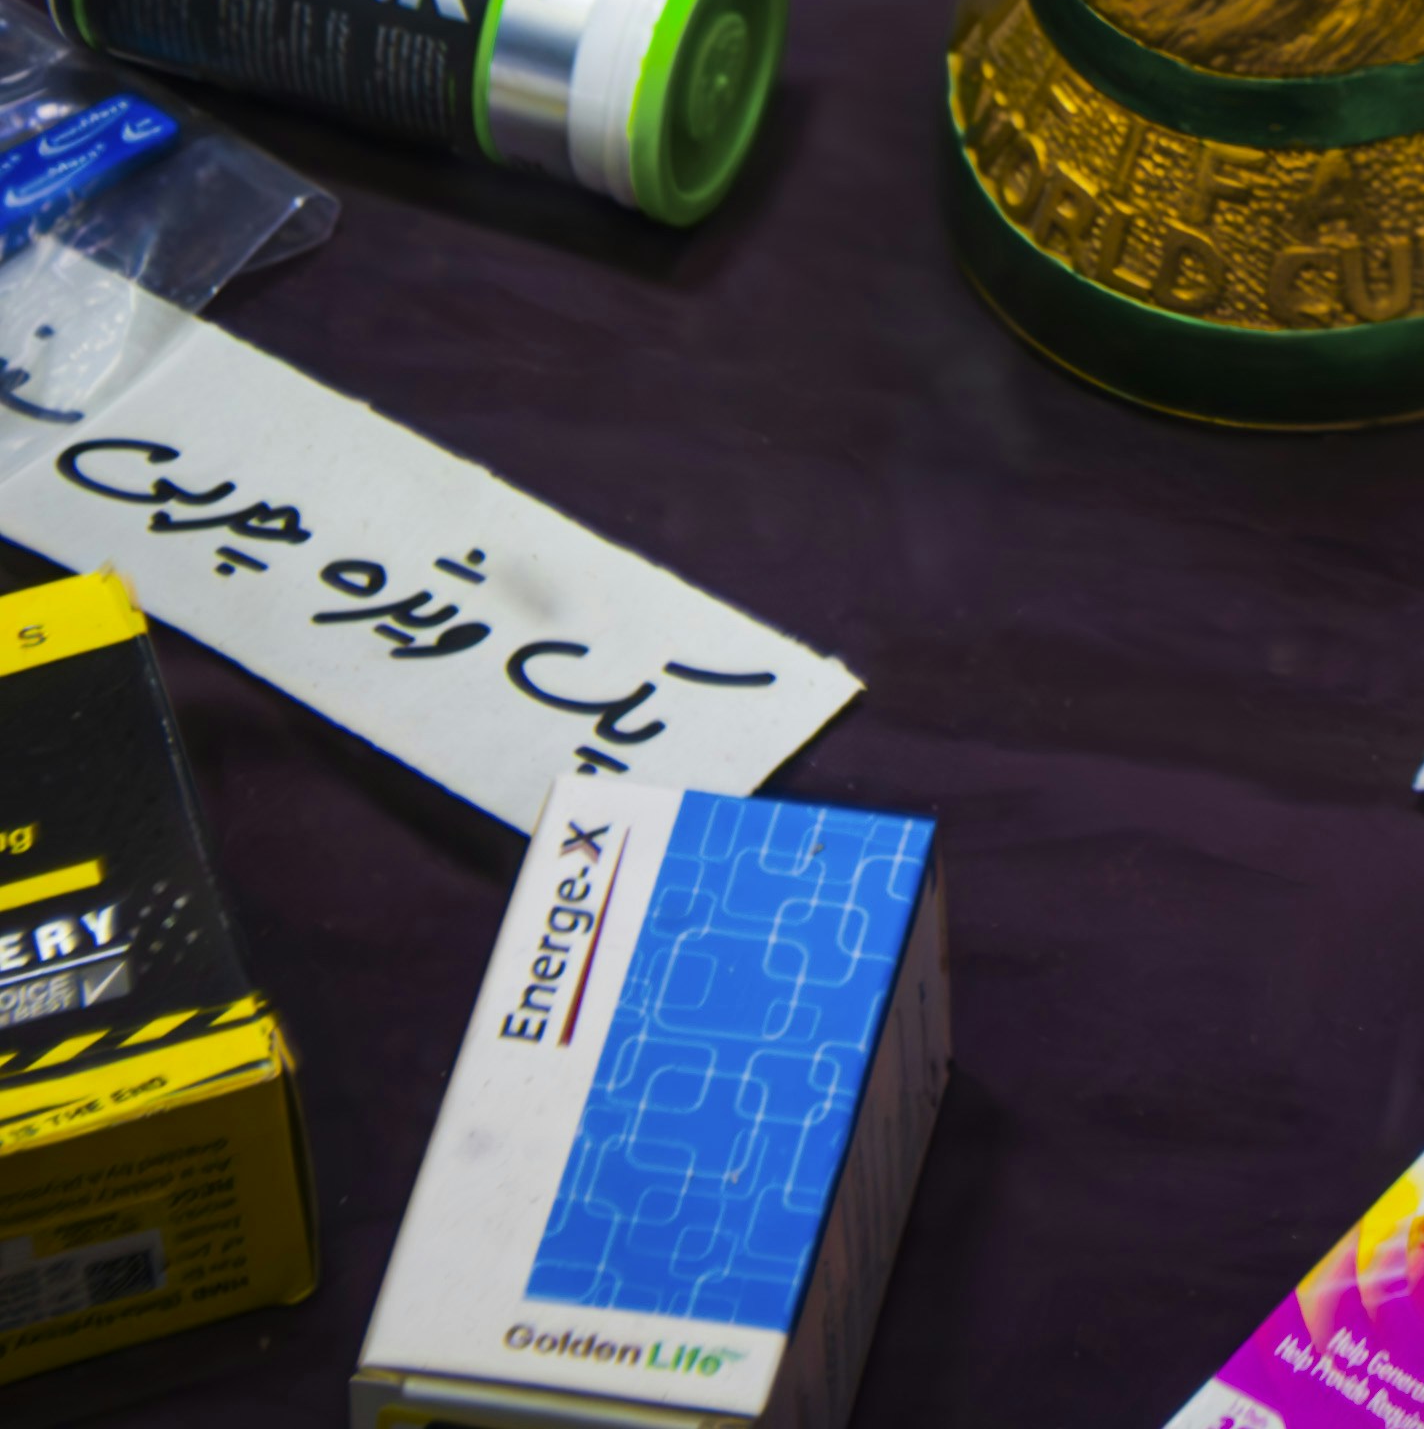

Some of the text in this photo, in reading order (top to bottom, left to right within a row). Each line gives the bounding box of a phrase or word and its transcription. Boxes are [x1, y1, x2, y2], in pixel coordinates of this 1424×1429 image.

[498, 820, 612, 1045] Energe-X
[502, 1321, 723, 1378] Golden Life
[1274, 1333, 1314, 1374] Help
[1327, 1326, 1370, 1369] Help
